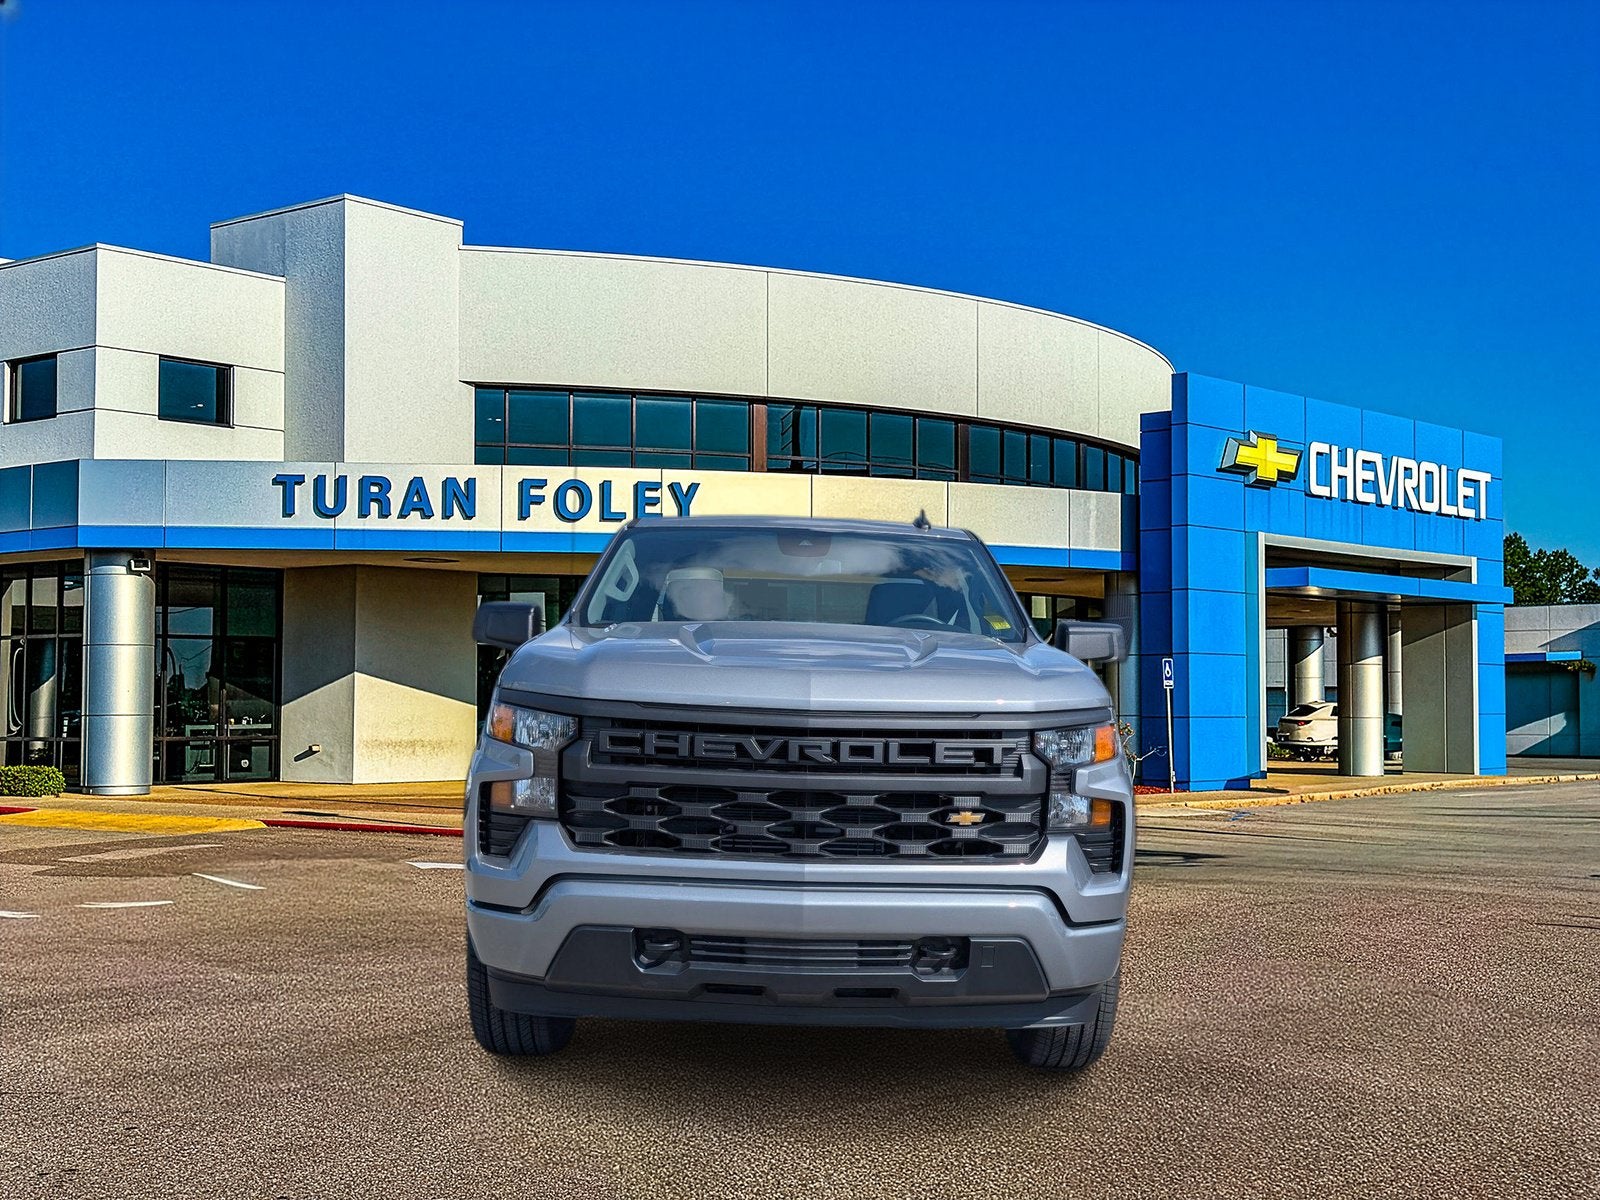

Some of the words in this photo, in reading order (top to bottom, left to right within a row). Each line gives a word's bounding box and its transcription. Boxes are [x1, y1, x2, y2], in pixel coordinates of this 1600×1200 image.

[272, 473, 477, 520] TURAN
[517, 478, 700, 522] FOLEY
[1307, 441, 1492, 520] CHEVROLET
[599, 729, 1018, 767] CHEVROLET
